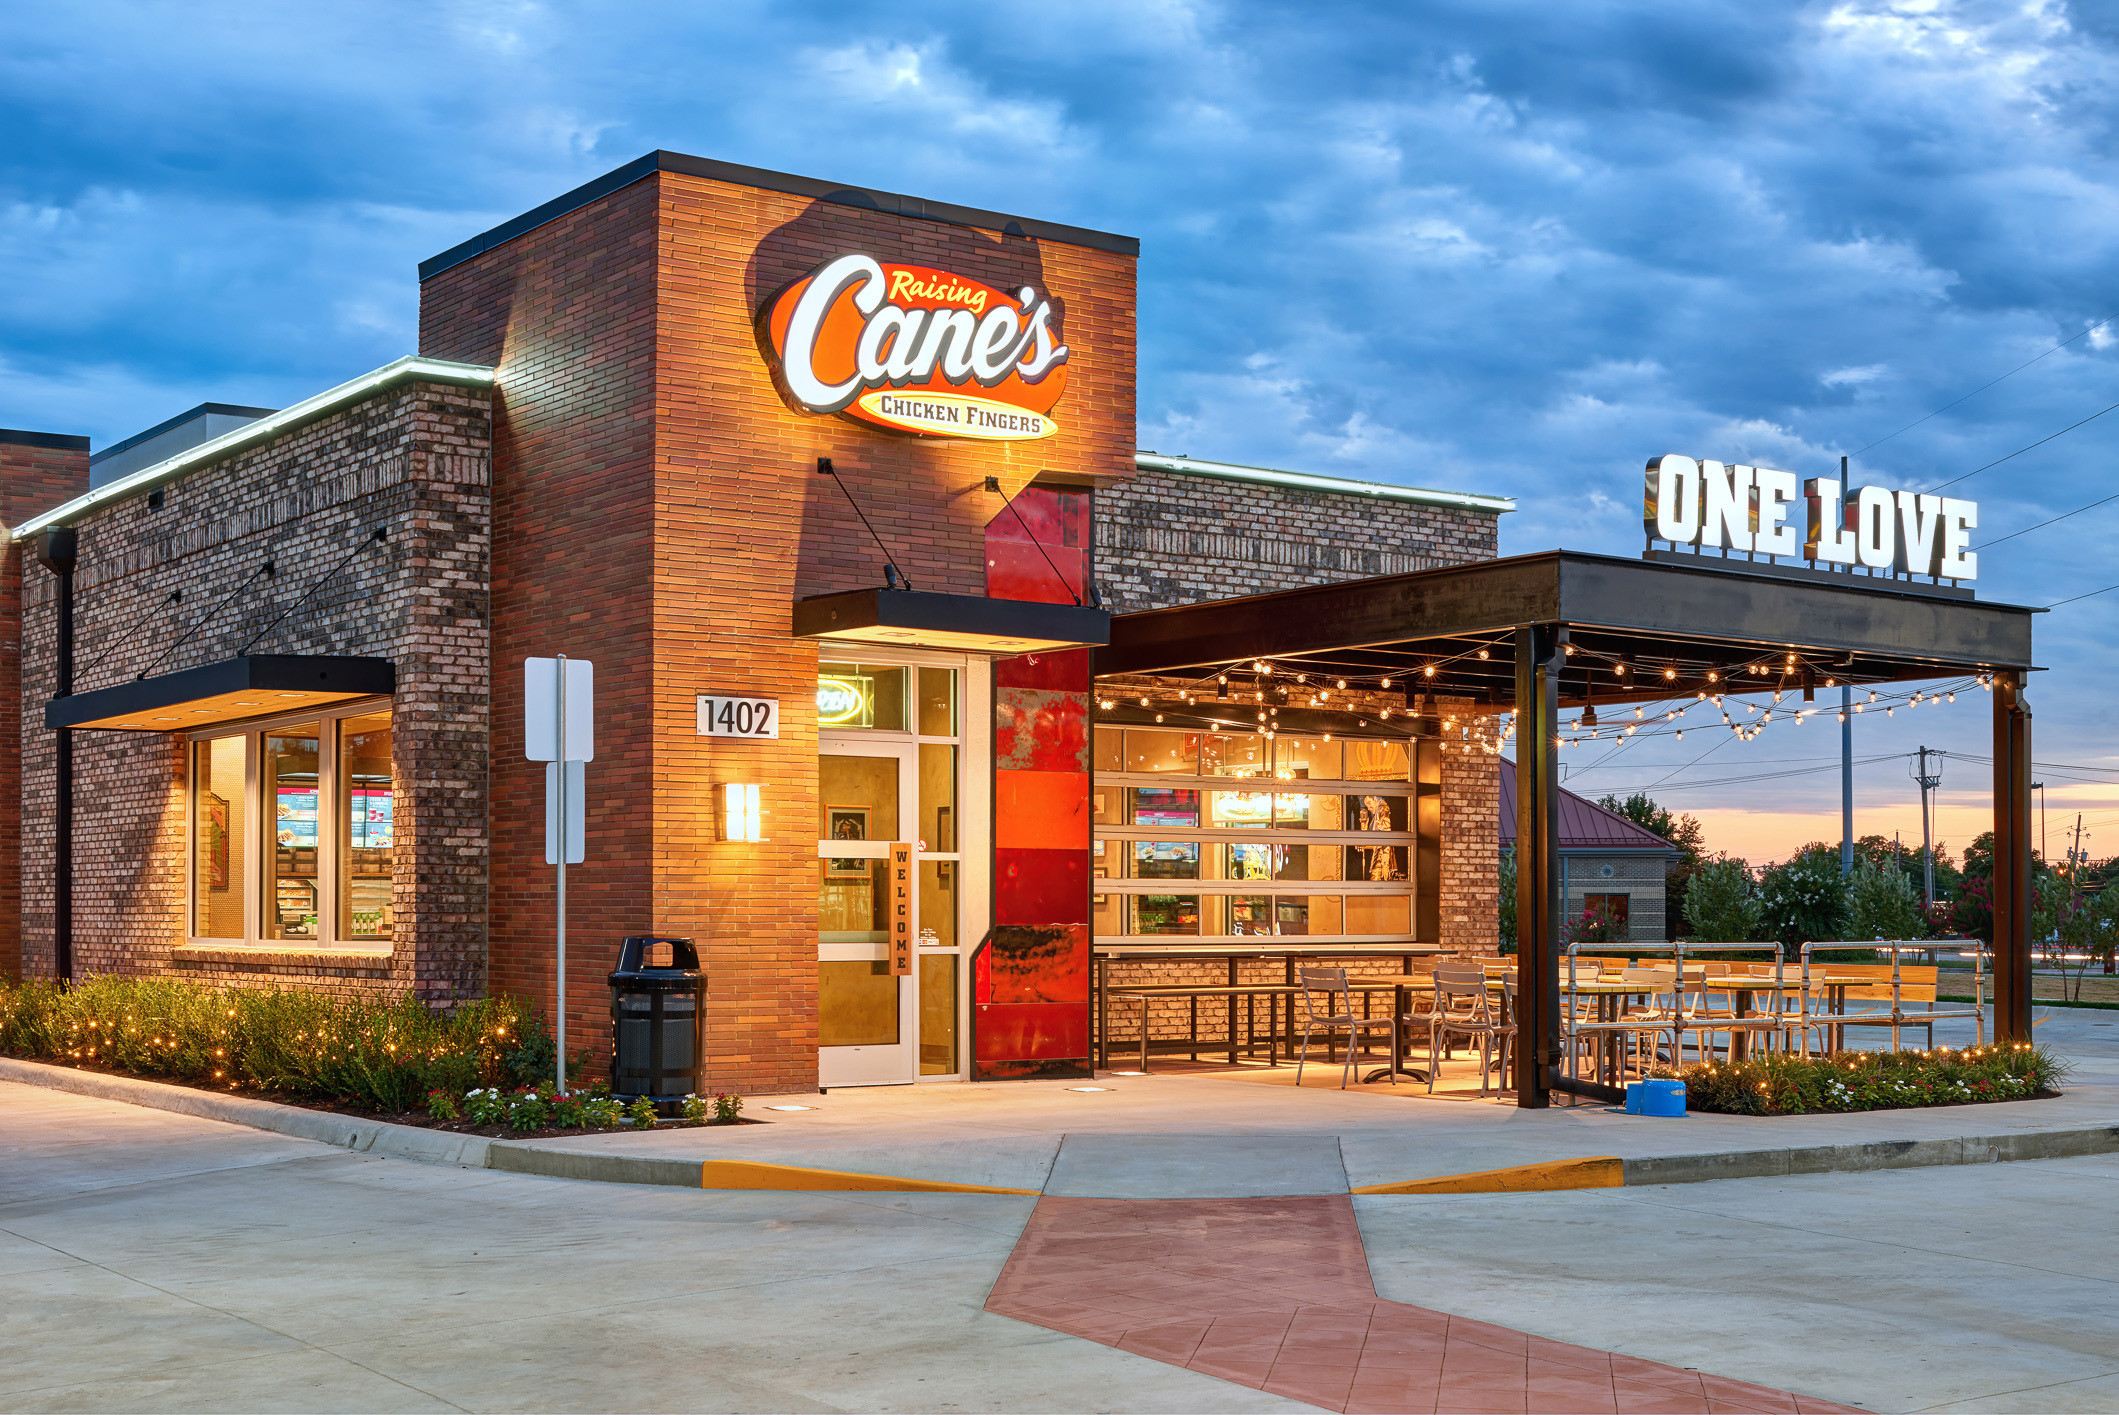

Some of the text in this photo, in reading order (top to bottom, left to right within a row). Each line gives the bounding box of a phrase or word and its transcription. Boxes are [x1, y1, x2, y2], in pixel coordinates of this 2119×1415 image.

[782, 253, 1069, 407] Cane's
[889, 270, 988, 314] Raising
[880, 395, 1041, 434] CHICKEN FINGERS
[1652, 453, 1978, 580] ONE LOVE
[704, 699, 771, 735] 1402
[896, 851, 908, 969] WELCOME
